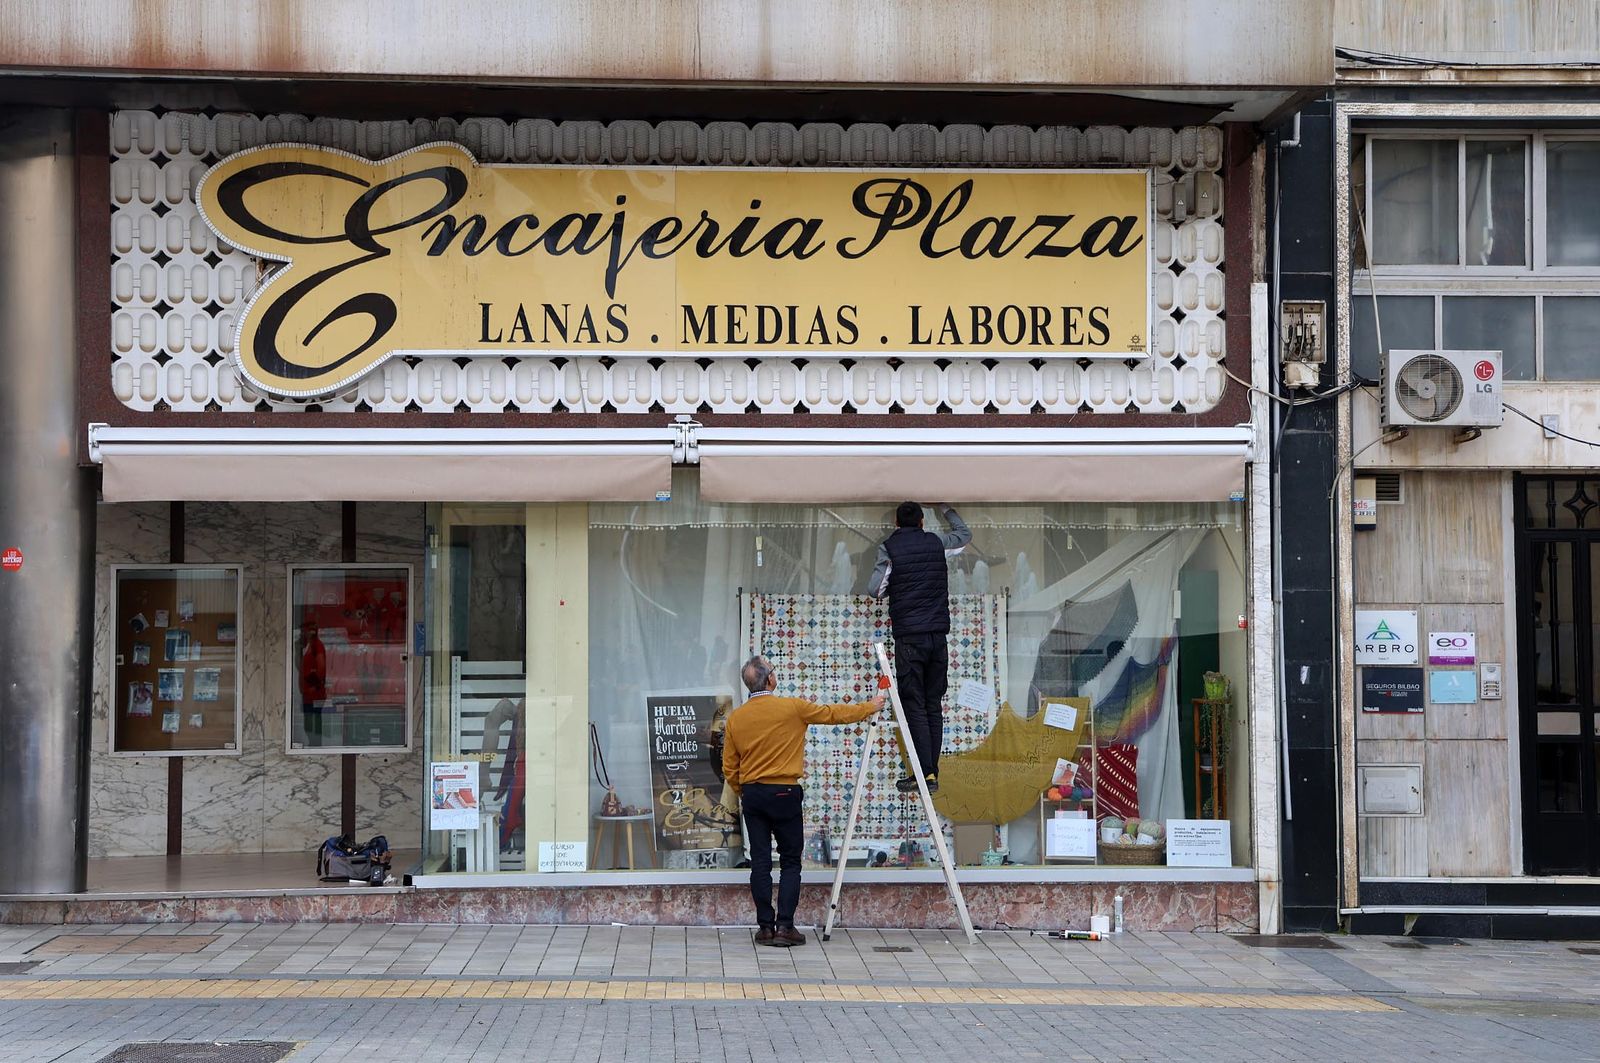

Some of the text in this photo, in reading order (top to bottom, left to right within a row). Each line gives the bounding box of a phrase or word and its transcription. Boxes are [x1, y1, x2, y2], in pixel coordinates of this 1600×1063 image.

[217, 159, 1143, 379] Encajeria Plaza
[479, 302, 629, 344] LANAS
[681, 304, 858, 345] MEDIAS
[909, 304, 1110, 346] LABORES
[1476, 384, 1493, 393] LG
[1355, 644, 1415, 653] ARBRO
[654, 705, 696, 717] HUELVA
[654, 717, 697, 736] Marchas
[656, 735, 698, 756] Cofrades
